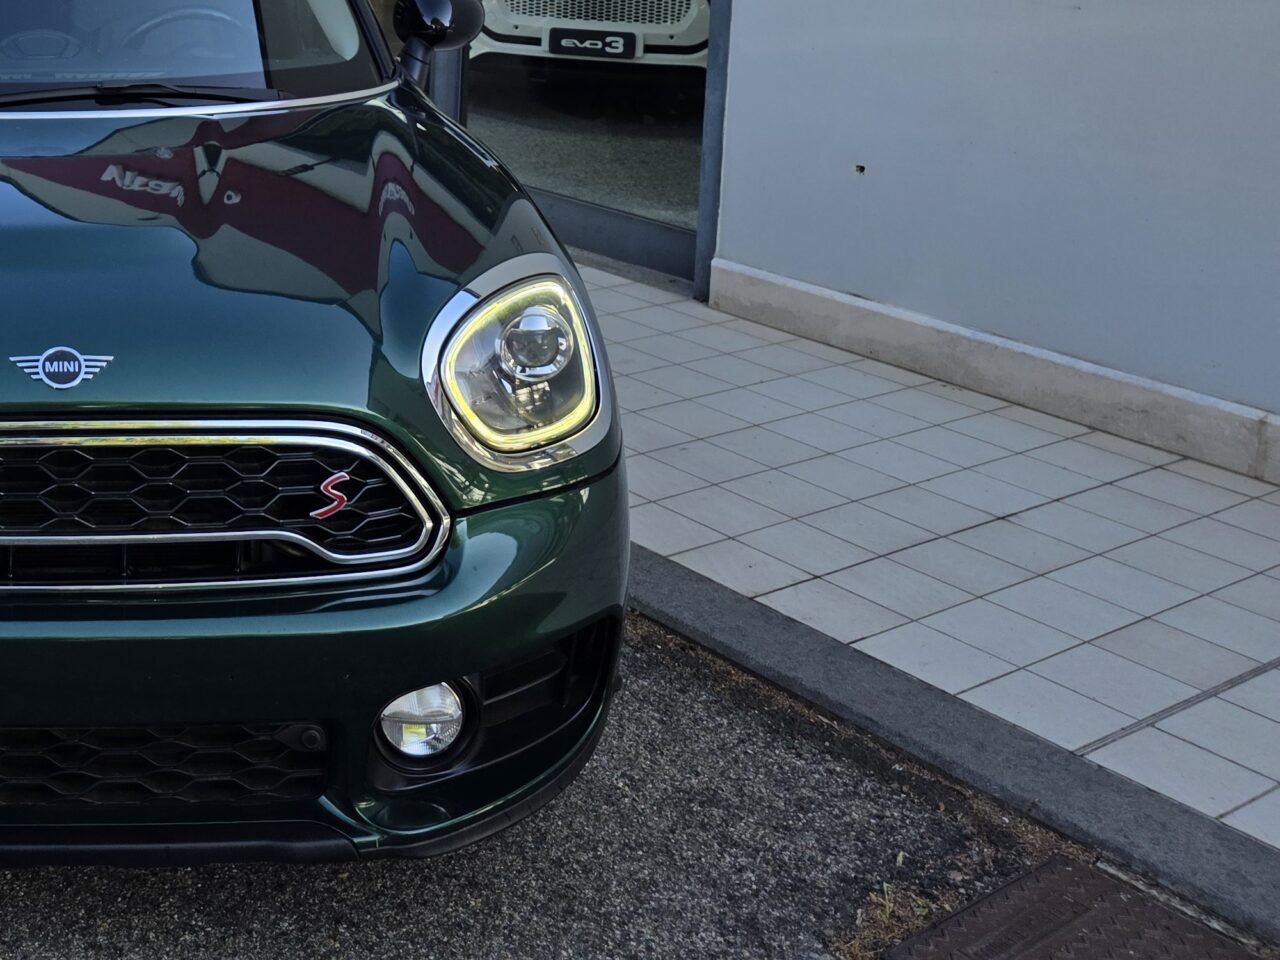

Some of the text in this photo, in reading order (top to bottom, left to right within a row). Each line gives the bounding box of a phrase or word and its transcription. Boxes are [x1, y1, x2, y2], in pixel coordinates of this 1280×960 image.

[561, 36, 624, 53] EVO 3
[45, 361, 79, 372] MINI
[310, 472, 350, 519] S
